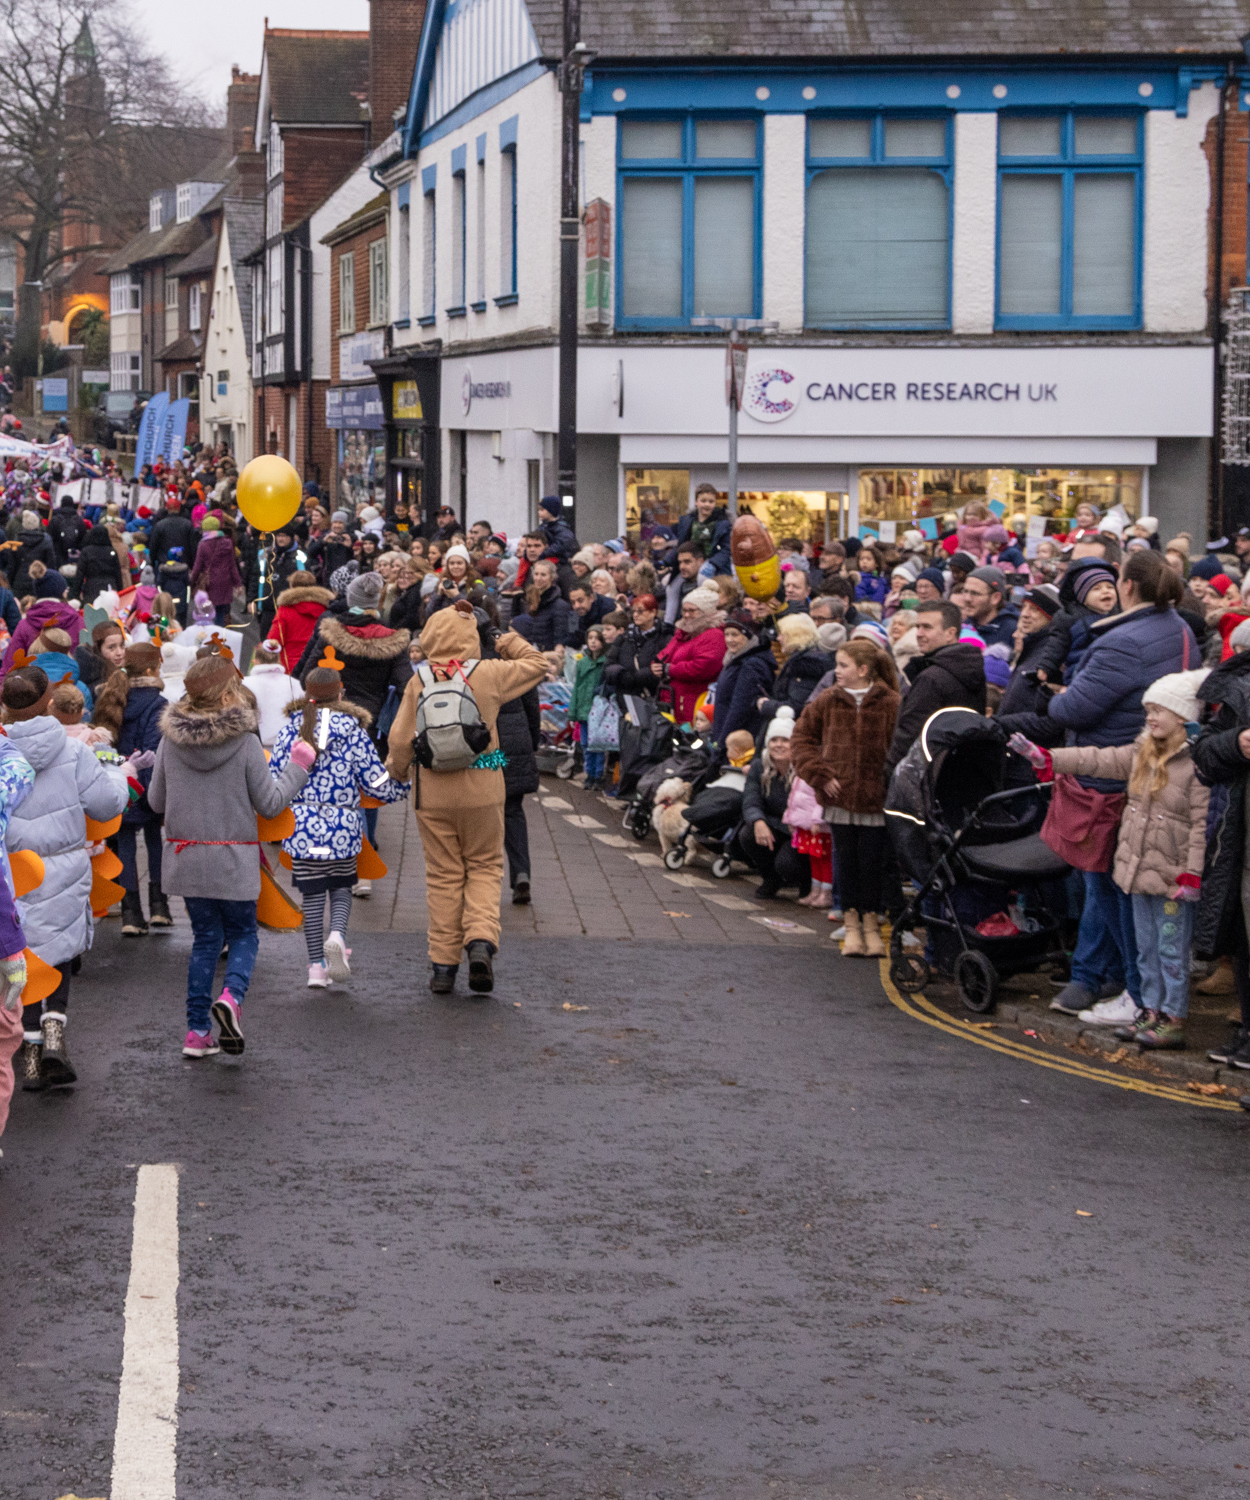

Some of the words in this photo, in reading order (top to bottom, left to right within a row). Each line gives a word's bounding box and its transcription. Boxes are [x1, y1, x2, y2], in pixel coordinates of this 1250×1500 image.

[806, 382, 897, 401] CANCER
[906, 382, 1020, 401] RESEARCH
[1027, 383, 1058, 402] UK
